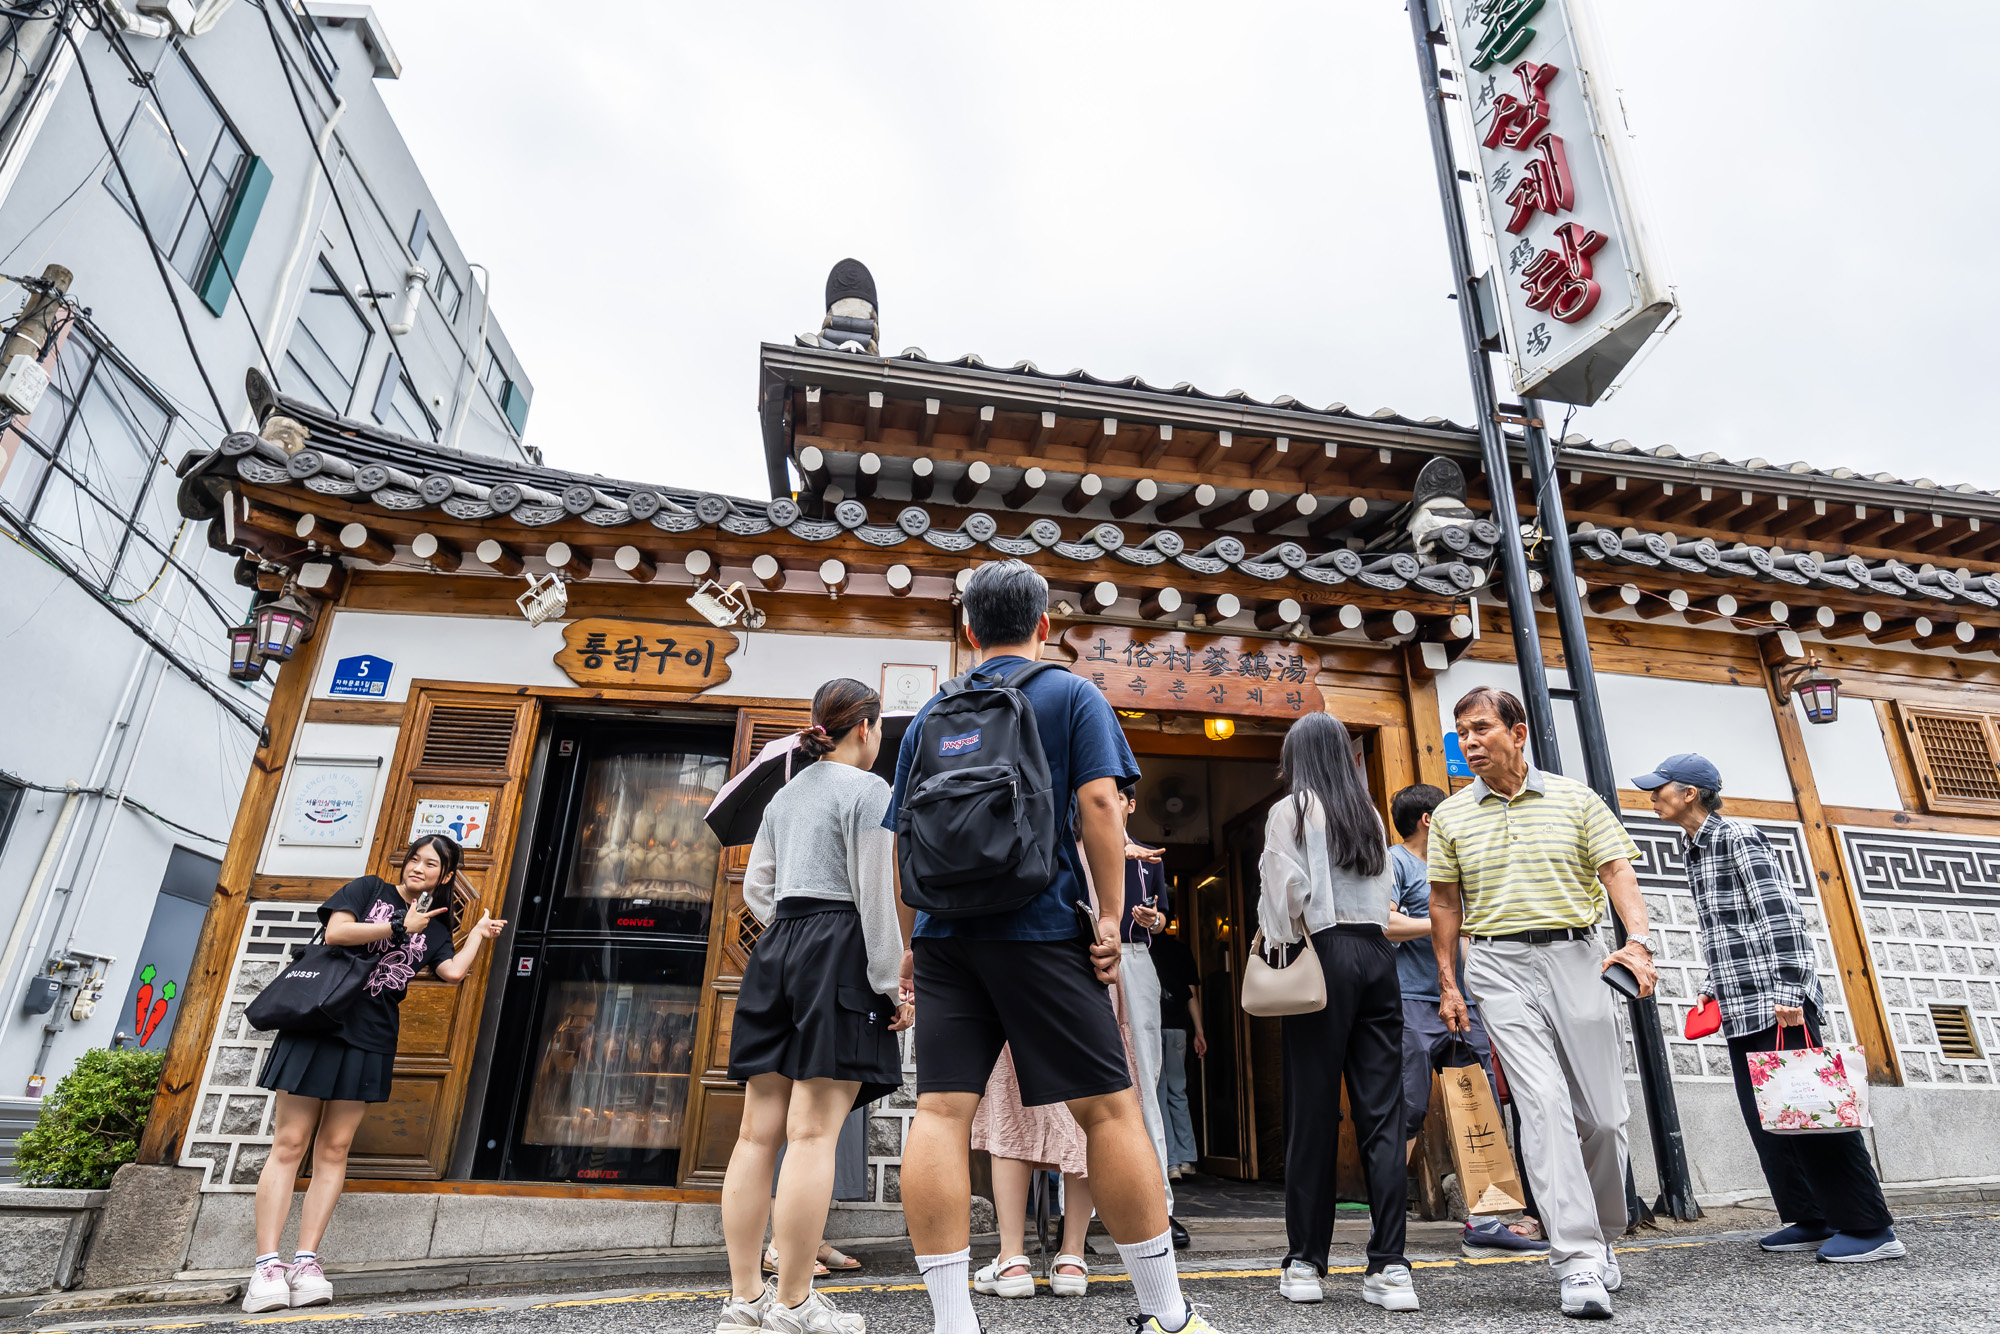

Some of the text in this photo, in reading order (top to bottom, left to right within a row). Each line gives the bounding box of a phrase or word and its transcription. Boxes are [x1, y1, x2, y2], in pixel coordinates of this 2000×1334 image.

[576, 632, 715, 678] 통닭구이
[357, 660, 371, 677] 5
[295, 774, 326, 817] EXCELLENCE
[340, 774, 359, 789] FOOD
[352, 790, 363, 818] SAFETY
[617, 918, 656, 927] CONVEX
[577, 1169, 619, 1179] CONVEX
